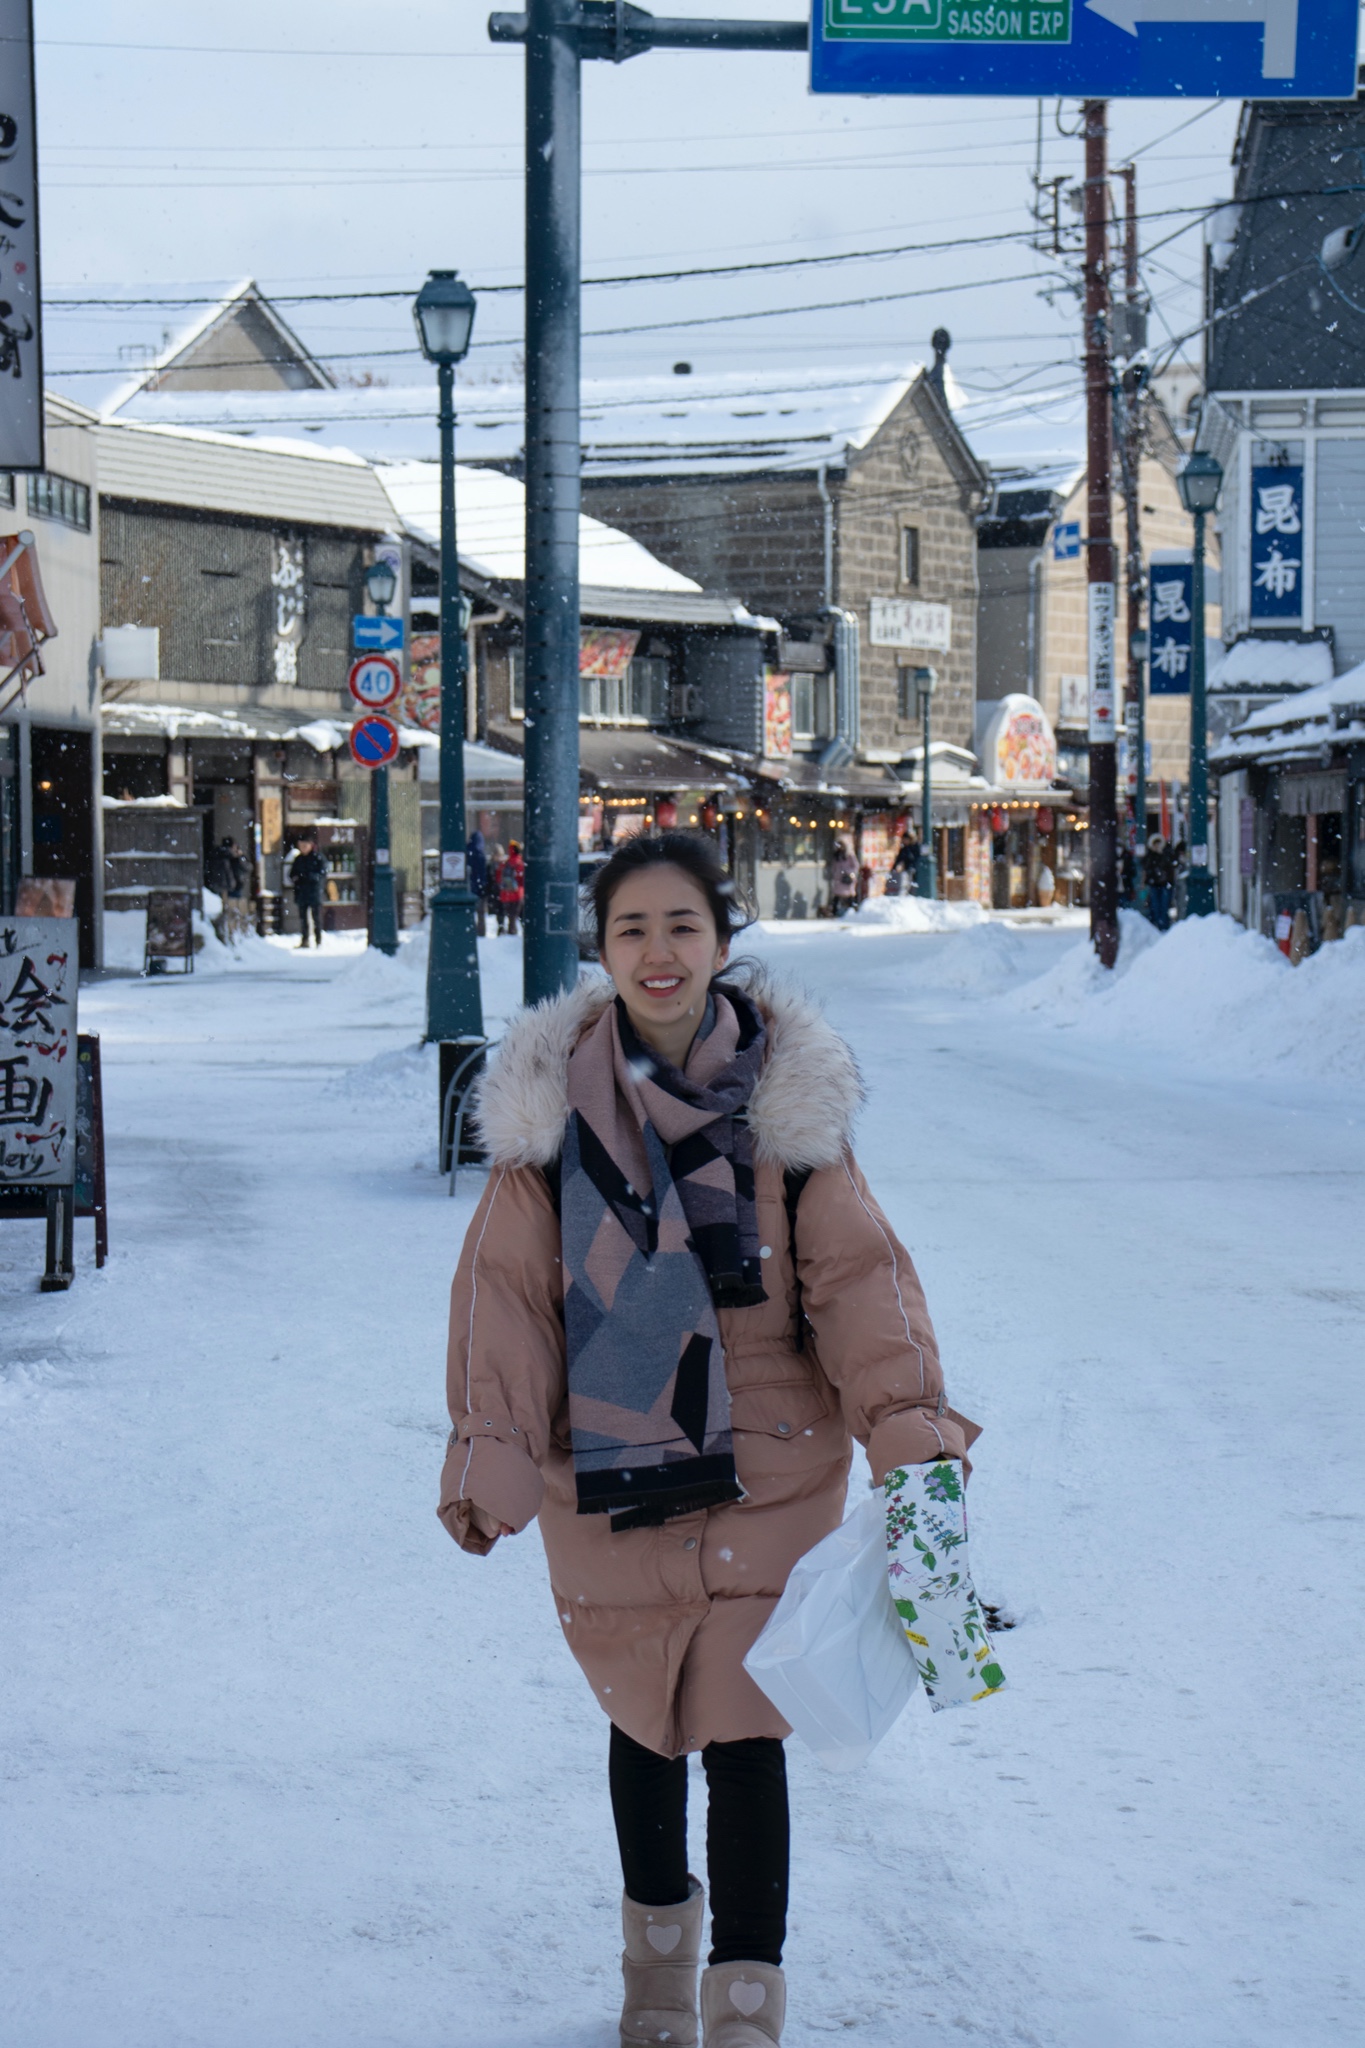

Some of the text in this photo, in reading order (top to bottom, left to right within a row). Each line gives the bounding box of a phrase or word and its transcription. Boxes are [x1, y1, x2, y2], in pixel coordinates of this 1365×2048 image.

[948, 10, 1063, 35] SASSON EXP
[1255, 484, 1300, 598] 昆布
[1152, 580, 1190, 678] 昆布
[361, 671, 391, 694] 40
